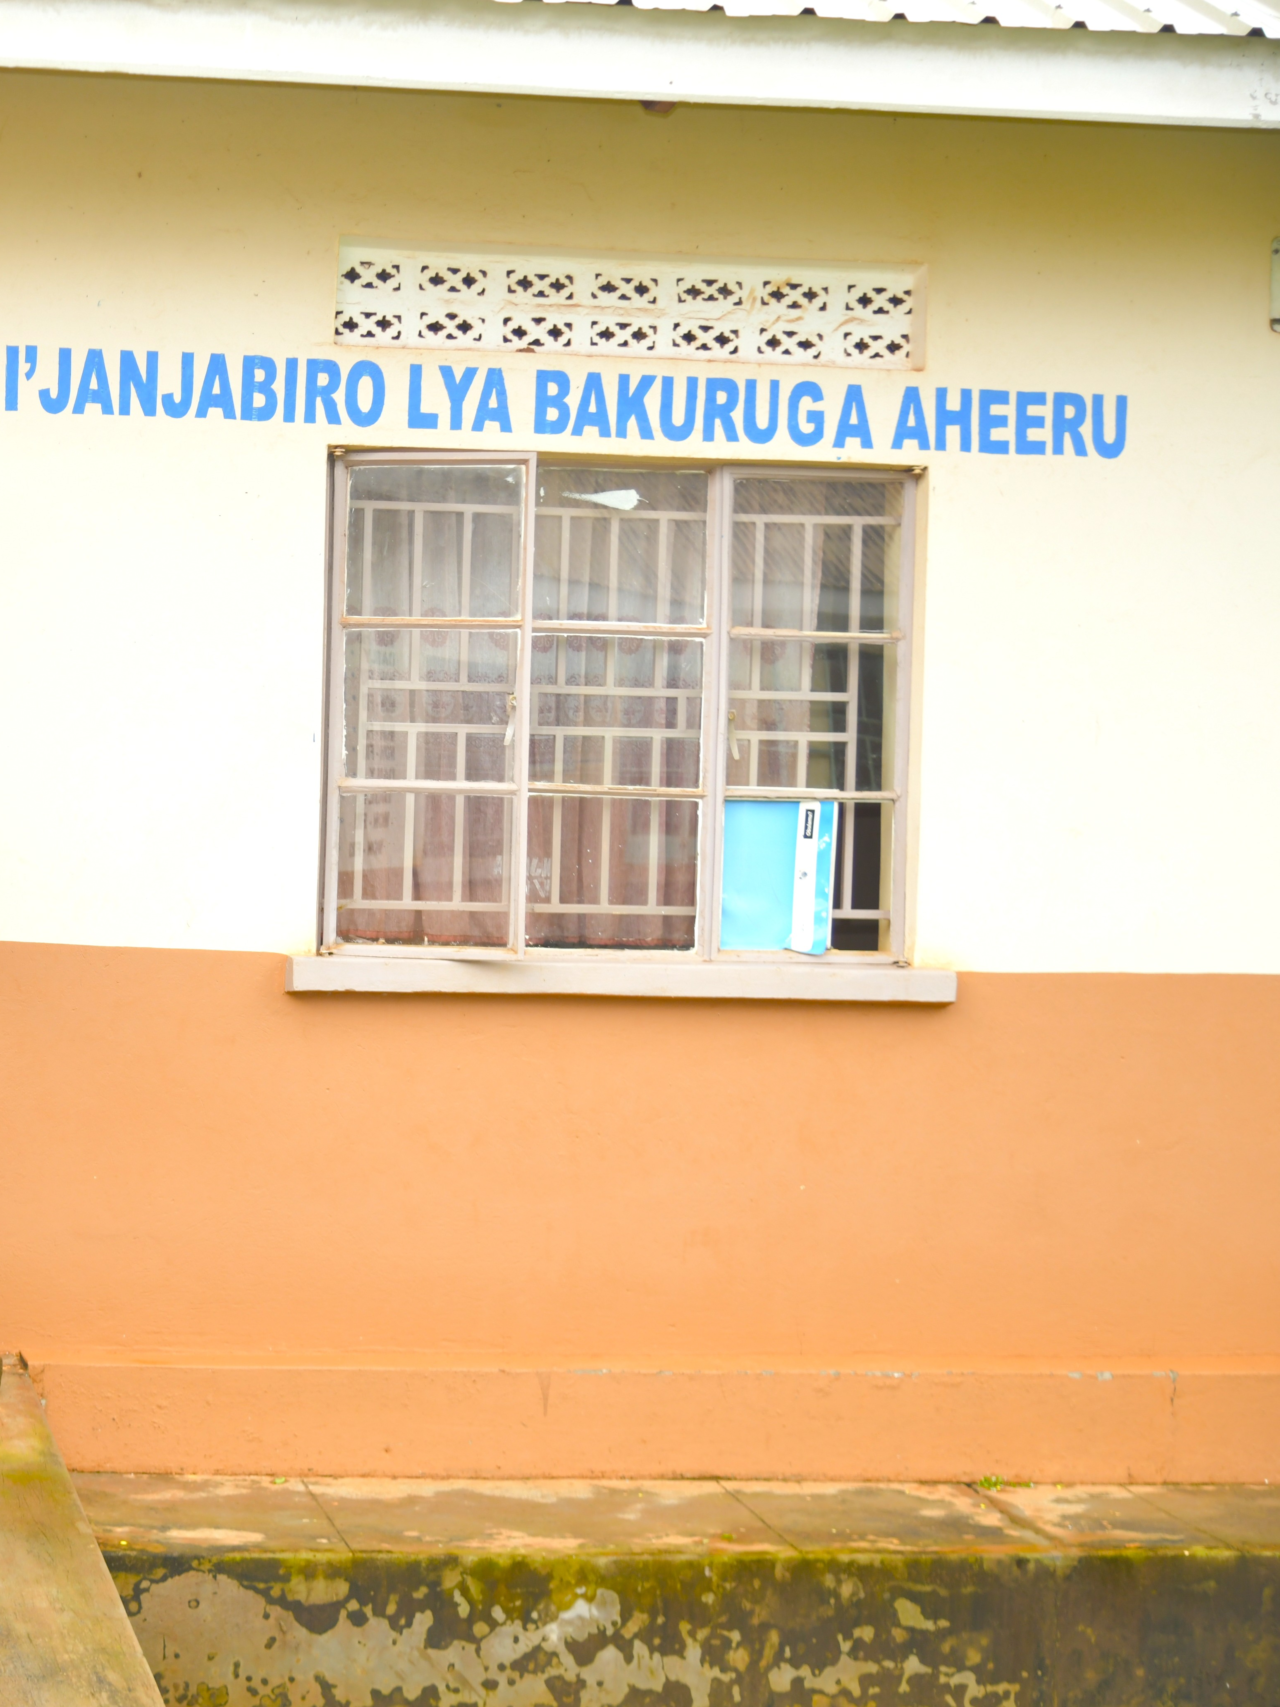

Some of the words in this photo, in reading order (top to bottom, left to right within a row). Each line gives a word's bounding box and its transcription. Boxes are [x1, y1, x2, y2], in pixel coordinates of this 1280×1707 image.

[407, 363, 513, 433] LYA
[533, 369, 874, 449] BAKURUGA
[891, 386, 1128, 460] AHEERU
